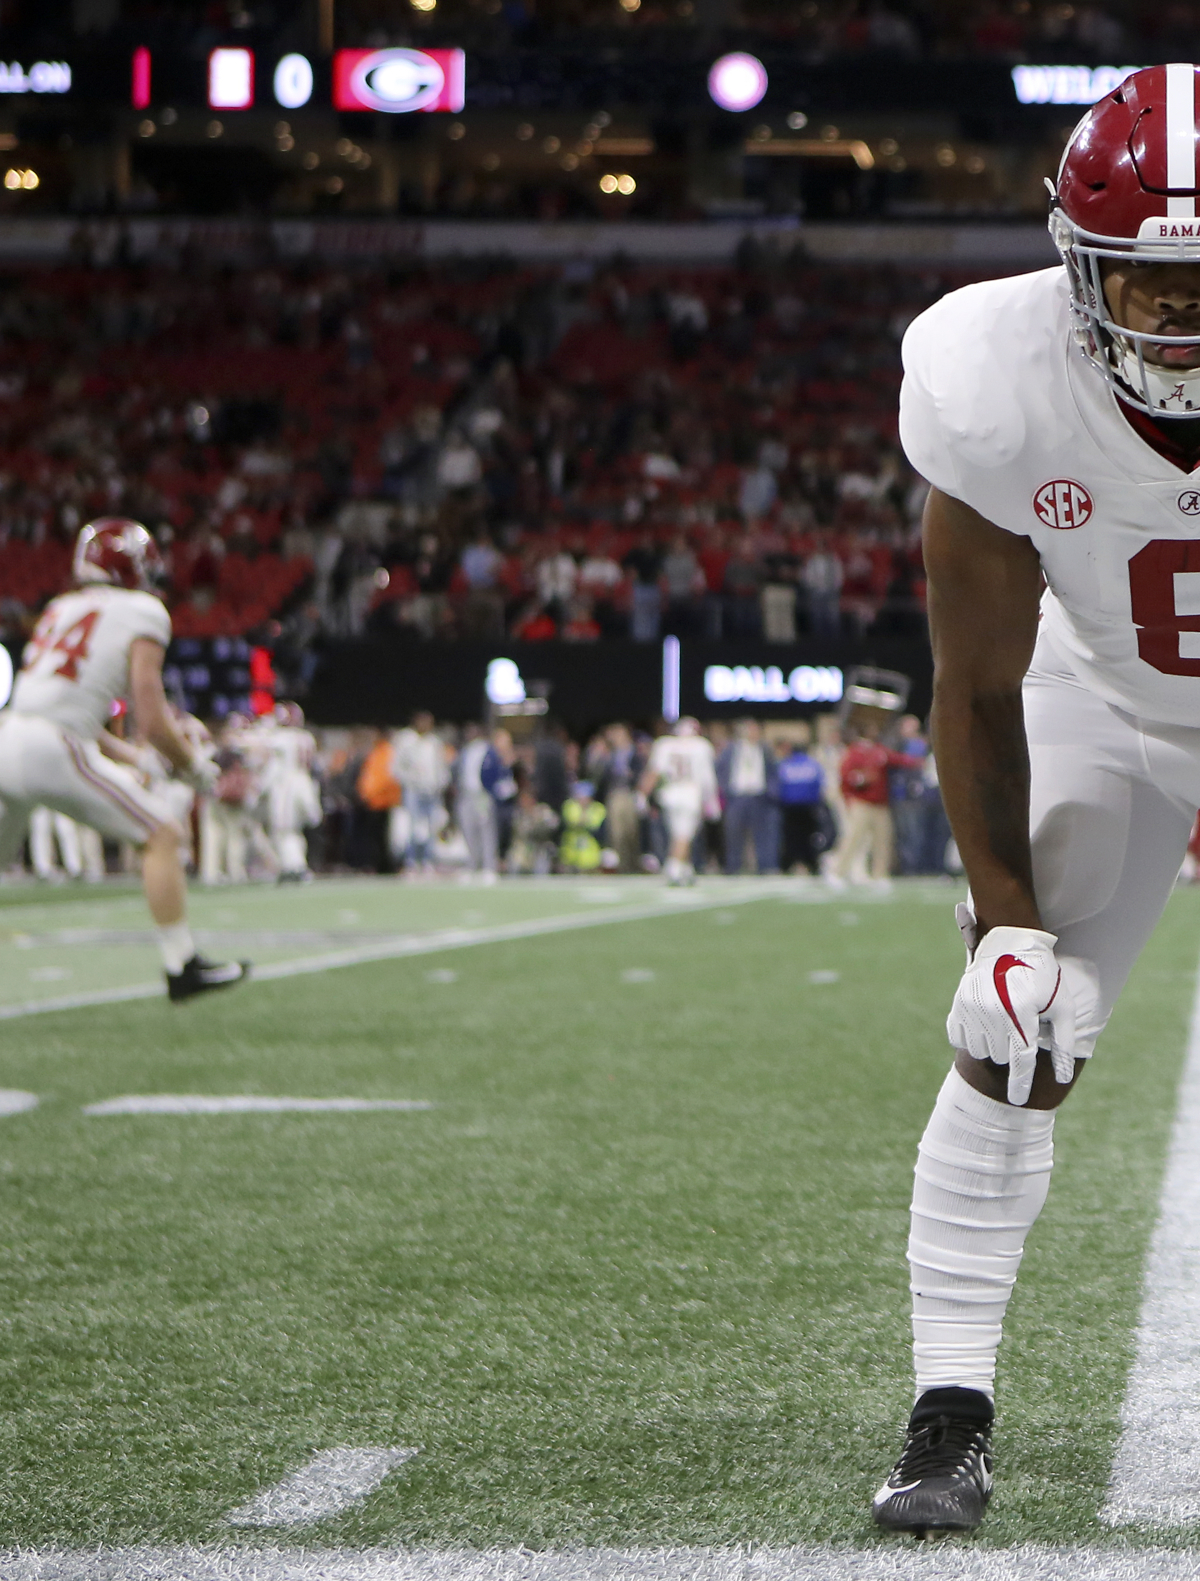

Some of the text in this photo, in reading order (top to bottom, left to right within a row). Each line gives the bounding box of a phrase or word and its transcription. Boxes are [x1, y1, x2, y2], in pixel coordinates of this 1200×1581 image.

[274, 53, 313, 108] 0
[1012, 65, 1142, 104] WELC
[1036, 480, 1090, 529] SEC
[704, 665, 844, 702] BALL ON
